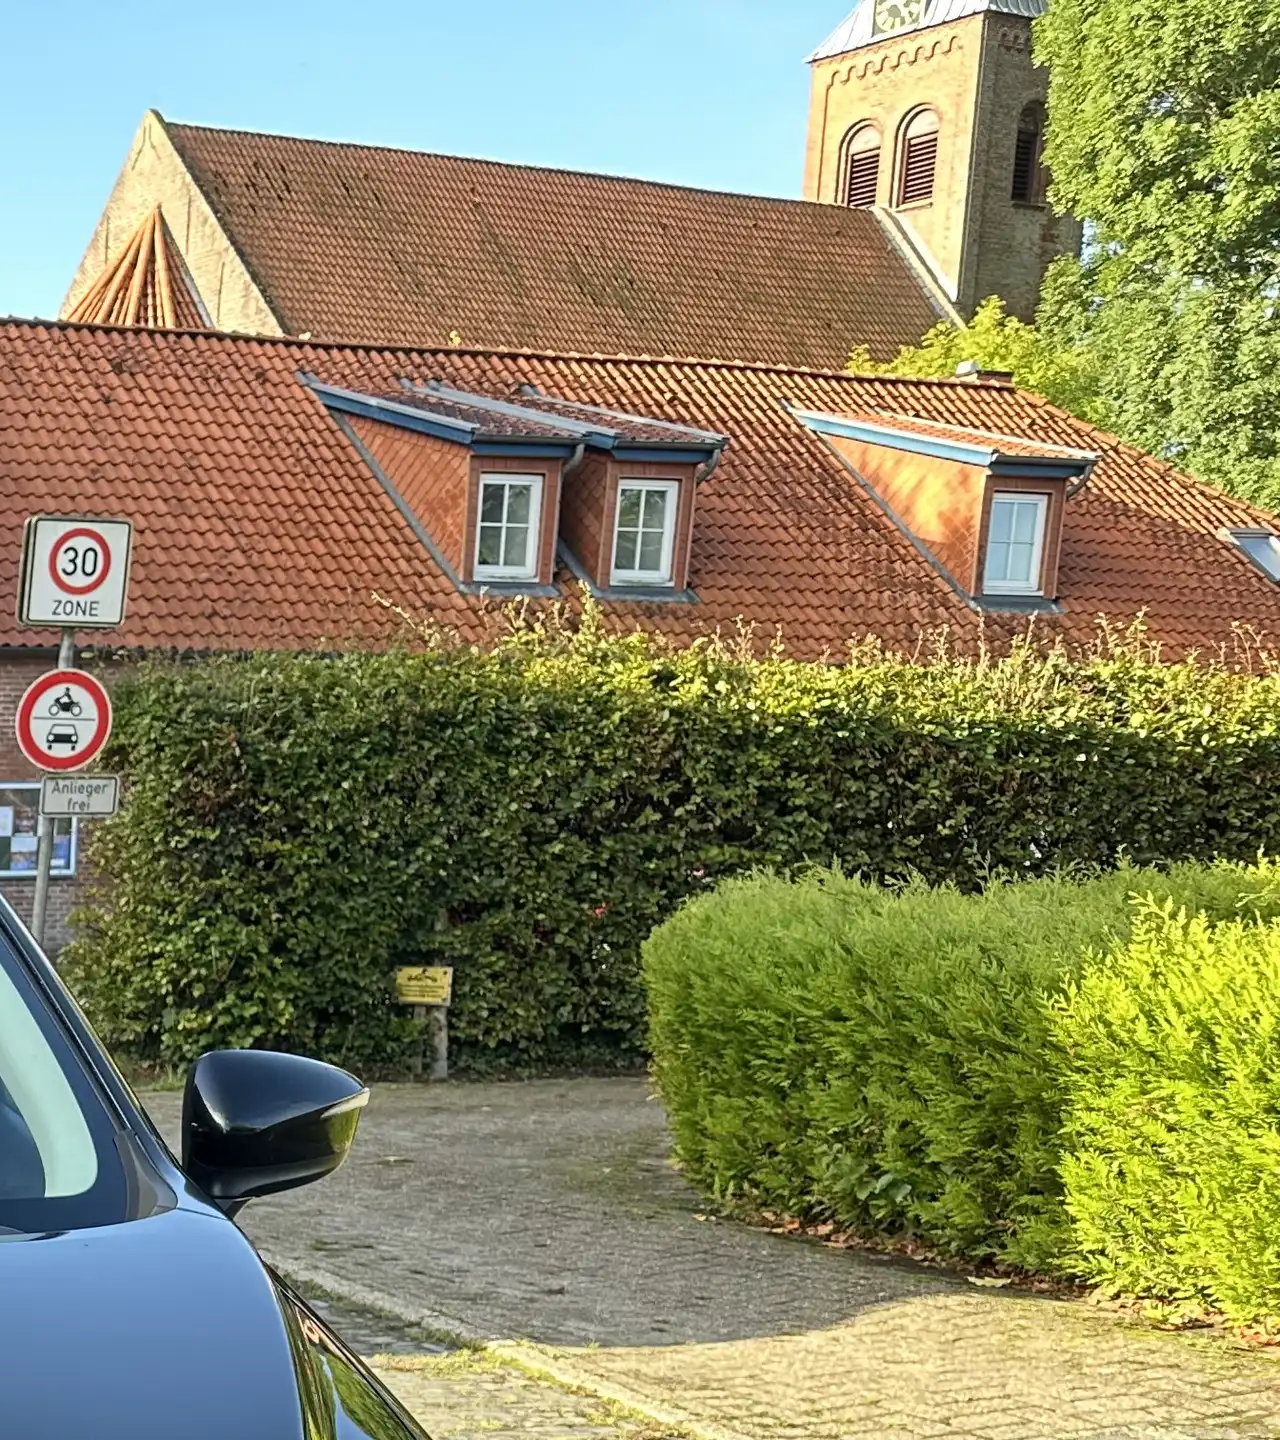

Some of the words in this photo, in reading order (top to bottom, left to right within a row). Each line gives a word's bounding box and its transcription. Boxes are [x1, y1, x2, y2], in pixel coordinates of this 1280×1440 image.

[61, 546, 98, 577] 30
[51, 599, 100, 617] ZONE
[51, 780, 109, 798] Anlieger
[67, 797, 91, 812] frei
